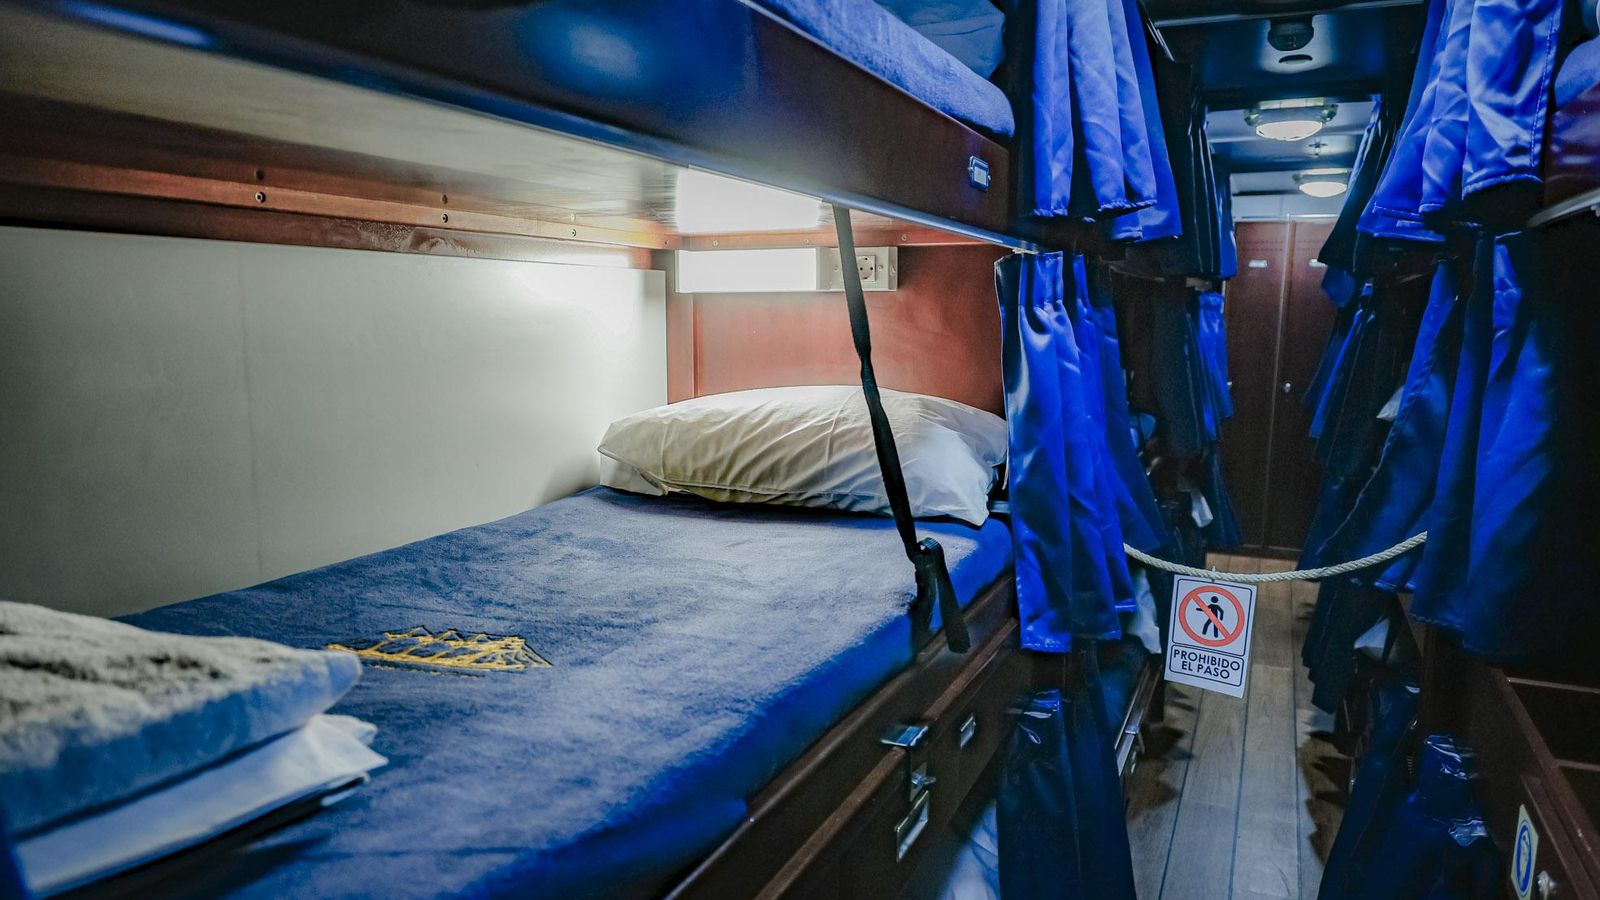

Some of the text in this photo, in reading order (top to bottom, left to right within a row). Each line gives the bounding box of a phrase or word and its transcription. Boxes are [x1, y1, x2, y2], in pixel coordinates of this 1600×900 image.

[1173, 649, 1240, 671] PROHIBIDO
[1181, 660, 1230, 679] EL PASO
